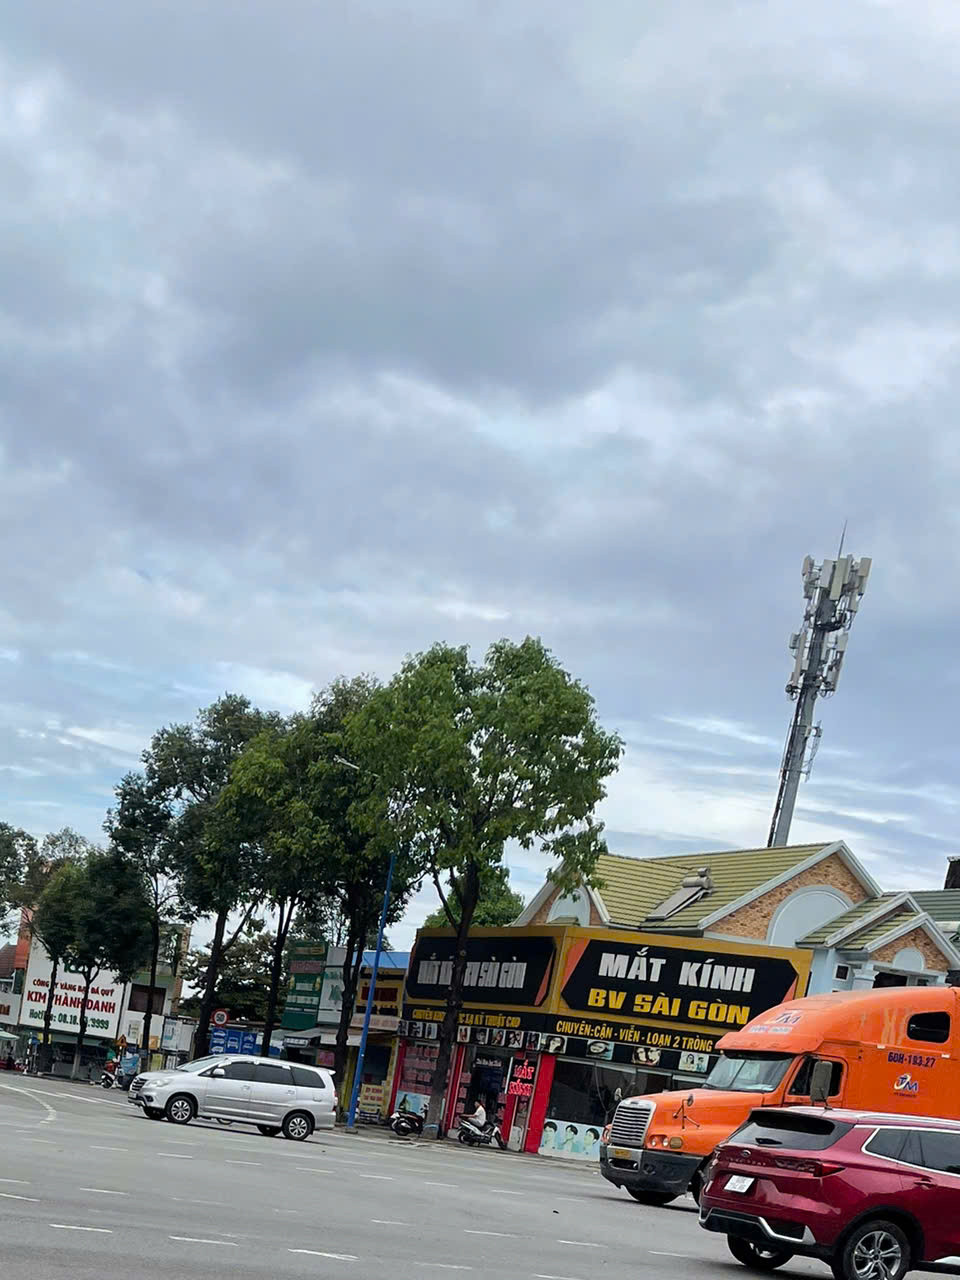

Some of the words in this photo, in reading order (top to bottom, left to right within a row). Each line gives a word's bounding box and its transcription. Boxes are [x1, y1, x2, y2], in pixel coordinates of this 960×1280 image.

[598, 947, 666, 982] MẮT
[678, 958, 755, 993] KÍNH
[28, 990, 47, 1004] KIM
[51, 992, 84, 1009] HÀNH
[86, 999, 116, 1014] DANH
[587, 987, 627, 1009] BV
[632, 992, 681, 1016] SÀI
[687, 998, 750, 1025] GÒN
[619, 1025, 640, 1043] VIỄN
[647, 1031, 671, 1049] LOẠN
[673, 1036, 680, 1047] 2
[681, 1036, 713, 1052] TRÒNG
